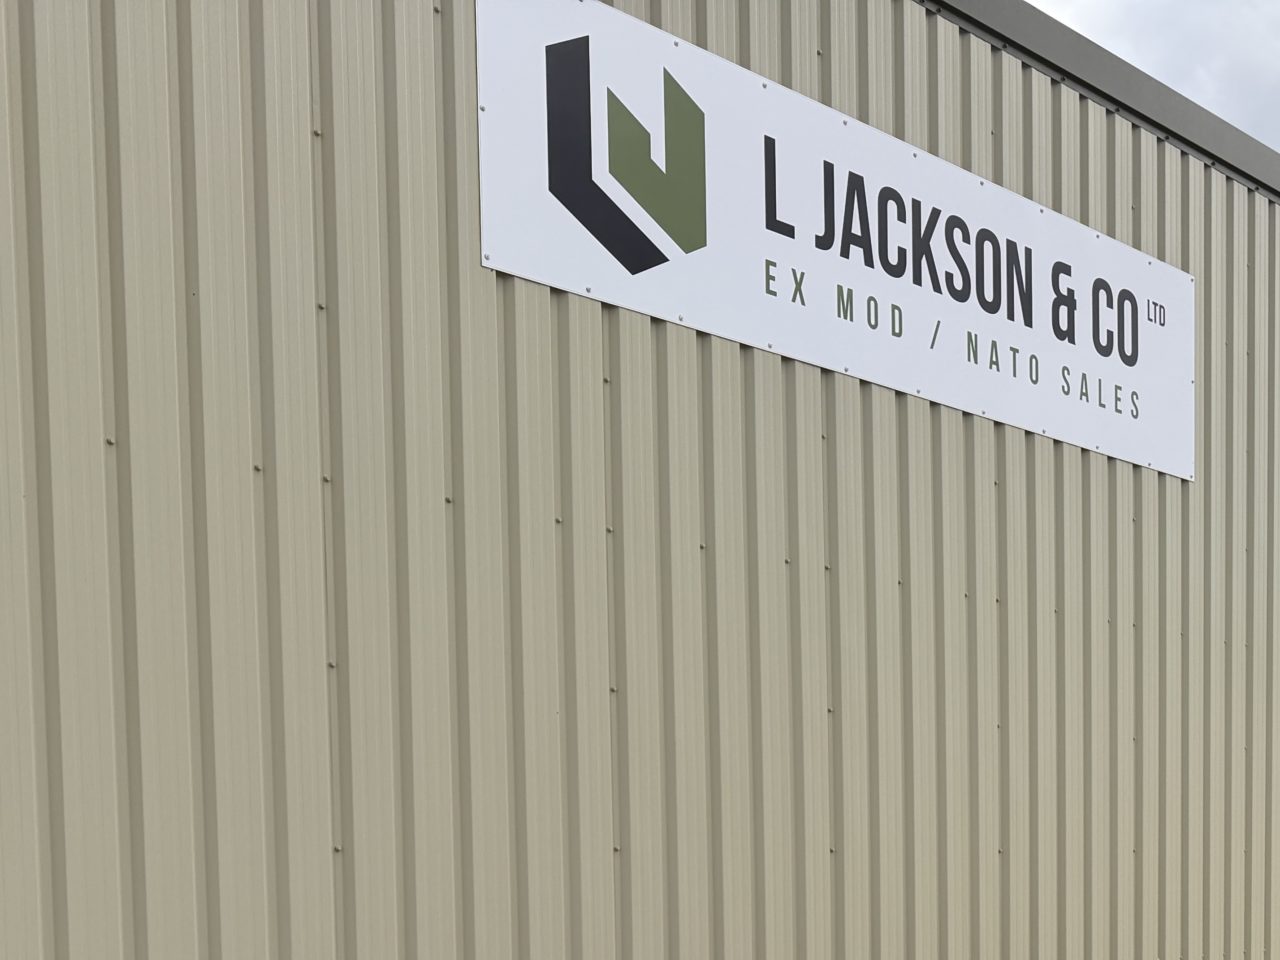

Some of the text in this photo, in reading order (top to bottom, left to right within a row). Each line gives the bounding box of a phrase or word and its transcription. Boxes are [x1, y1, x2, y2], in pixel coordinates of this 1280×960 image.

[763, 134, 1166, 368] L JACKSON & CO LTD
[764, 258, 1140, 420] EX MOD / NATO SALES
